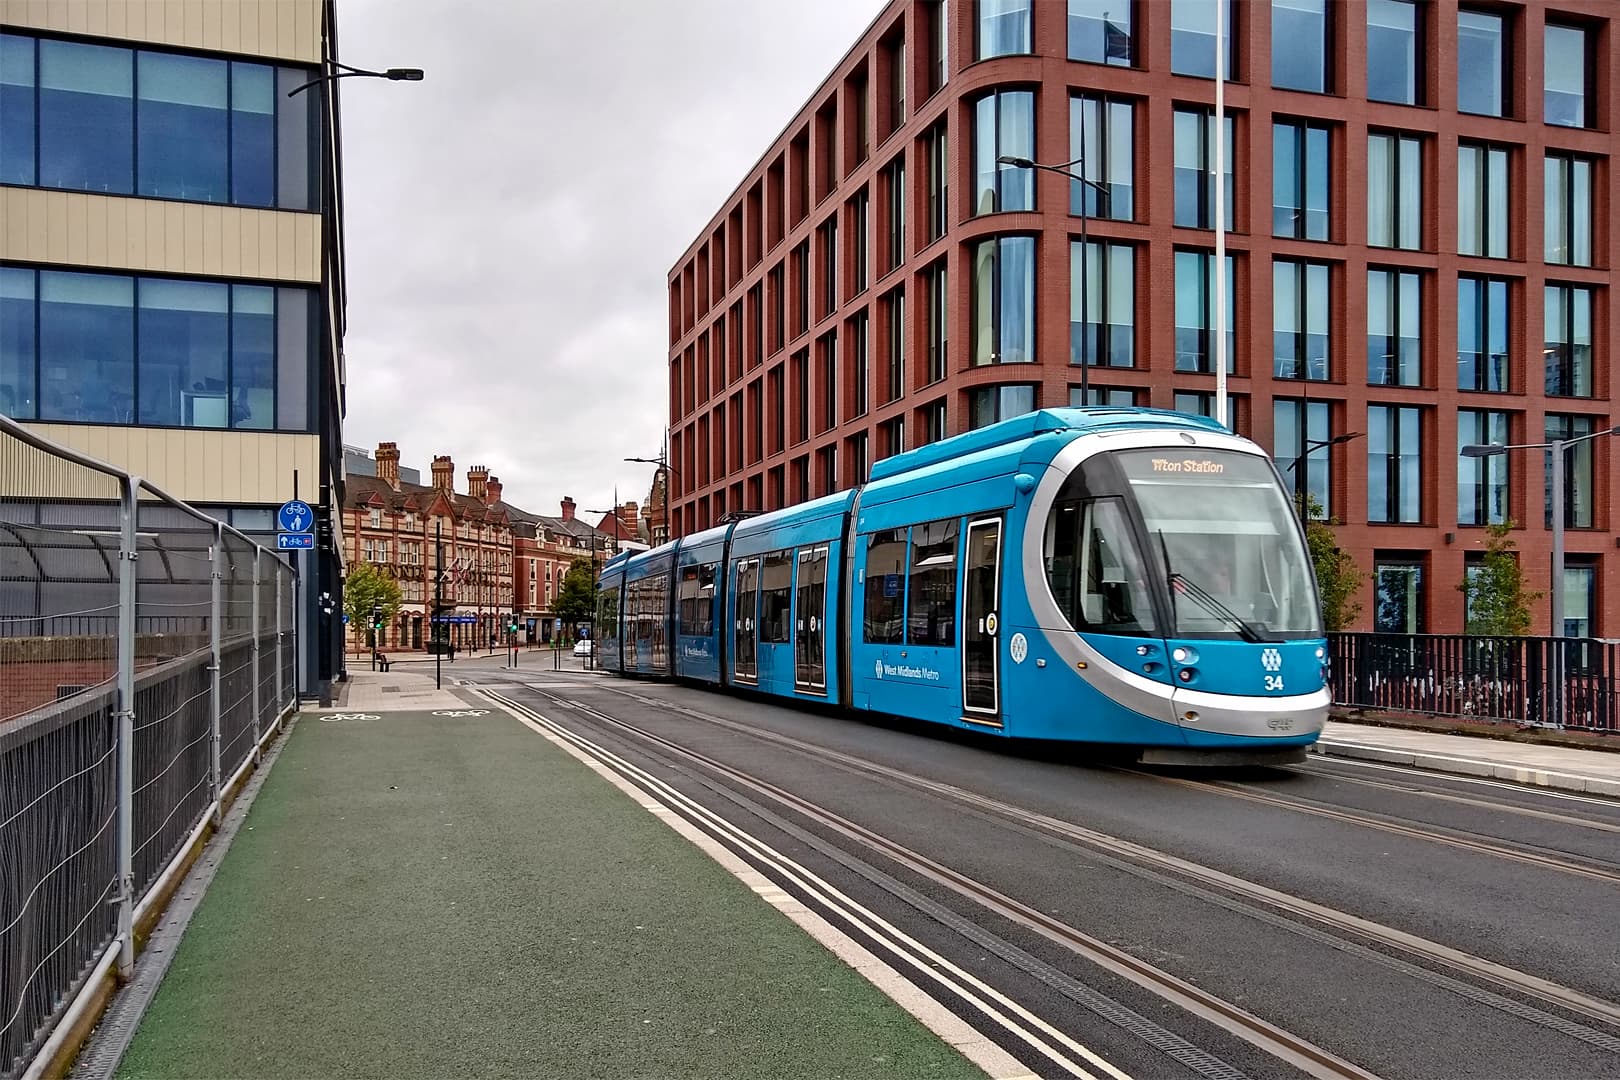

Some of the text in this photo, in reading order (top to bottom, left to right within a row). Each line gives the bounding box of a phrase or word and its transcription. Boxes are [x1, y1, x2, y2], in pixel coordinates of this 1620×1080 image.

[1183, 459, 1224, 473] Station
[883, 664, 940, 681] West Midlands Metro
[1264, 675, 1285, 691] 34
